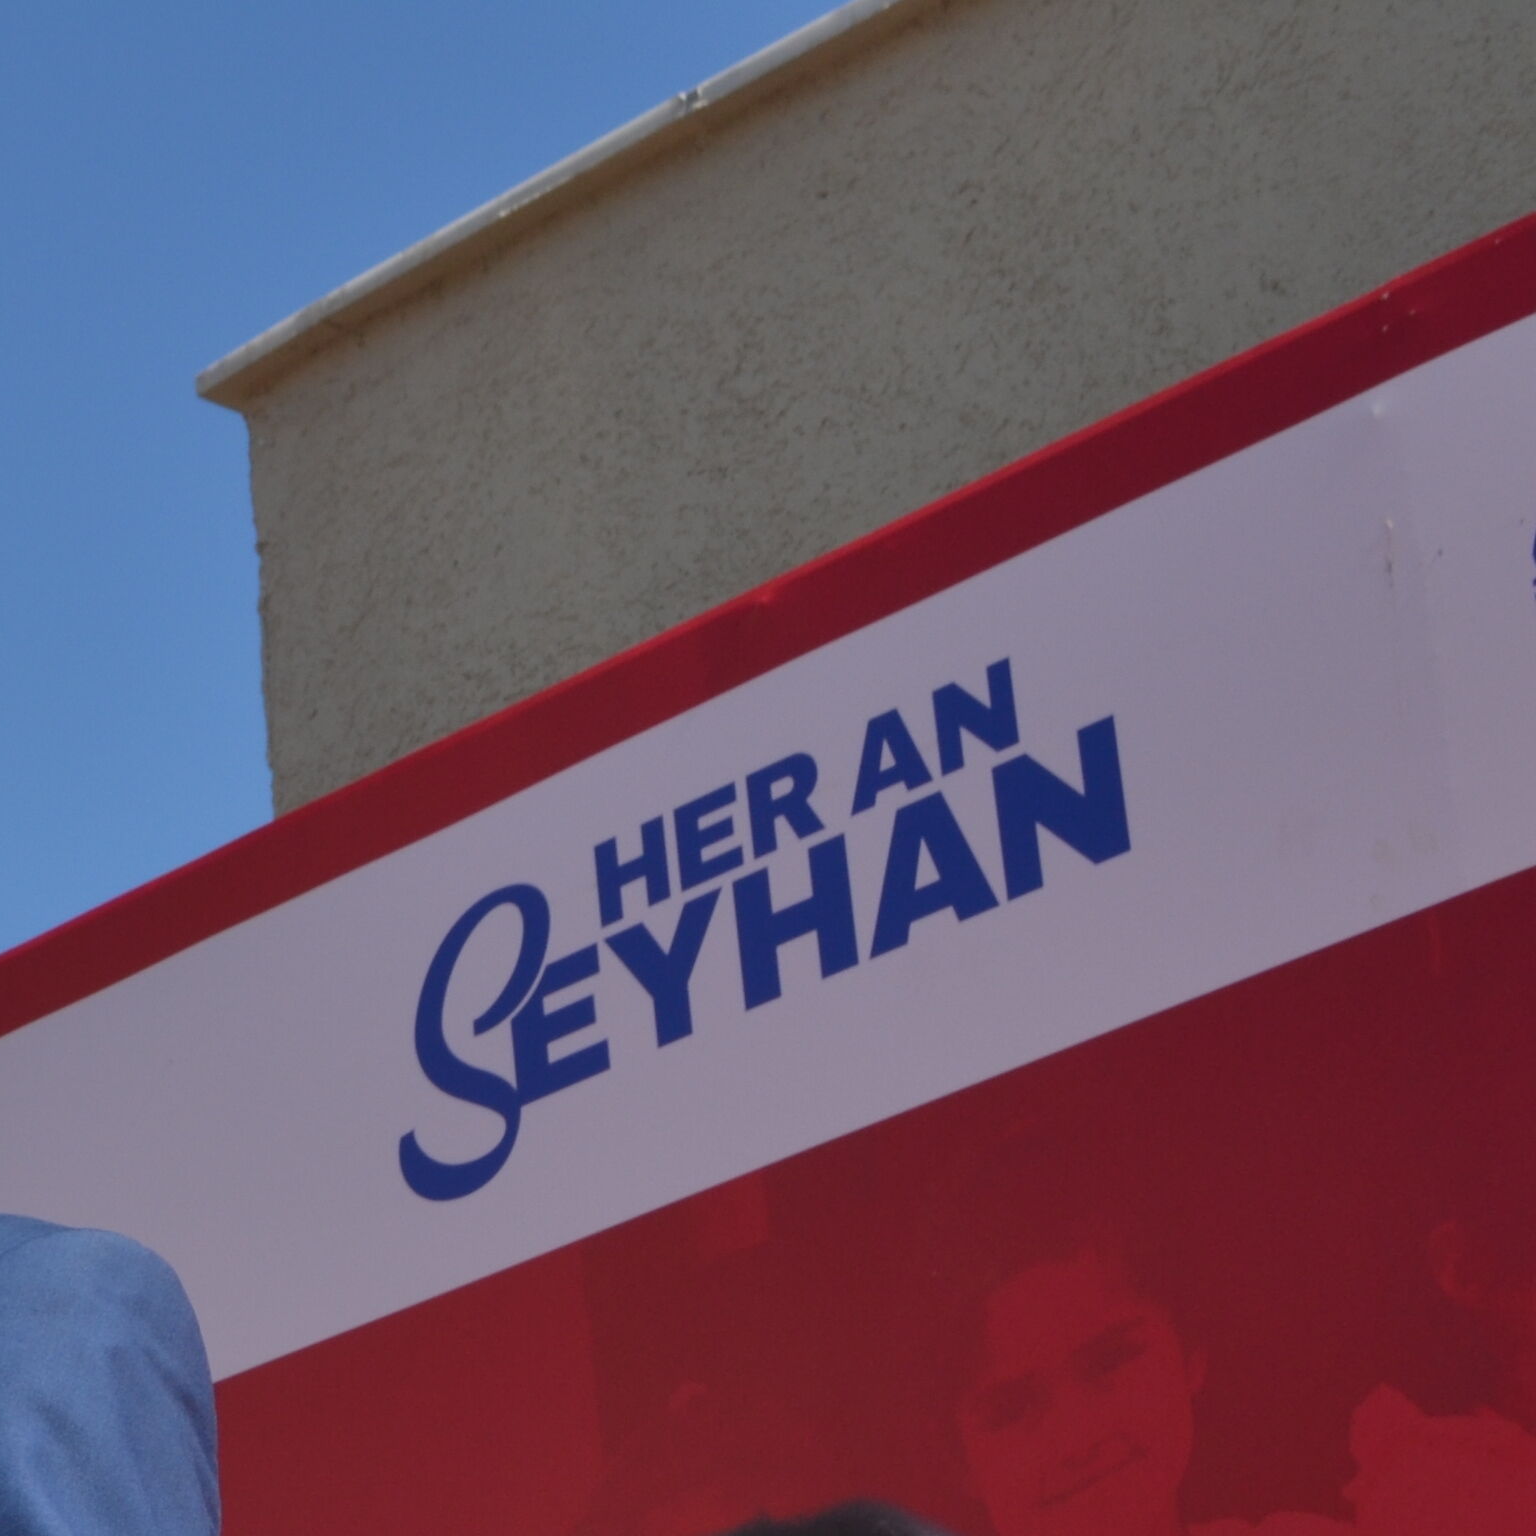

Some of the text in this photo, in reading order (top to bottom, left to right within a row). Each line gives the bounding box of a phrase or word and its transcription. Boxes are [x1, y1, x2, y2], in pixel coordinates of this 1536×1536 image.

[398, 714, 1131, 1201] SEYHAN
[593, 657, 1021, 928] HER AN
